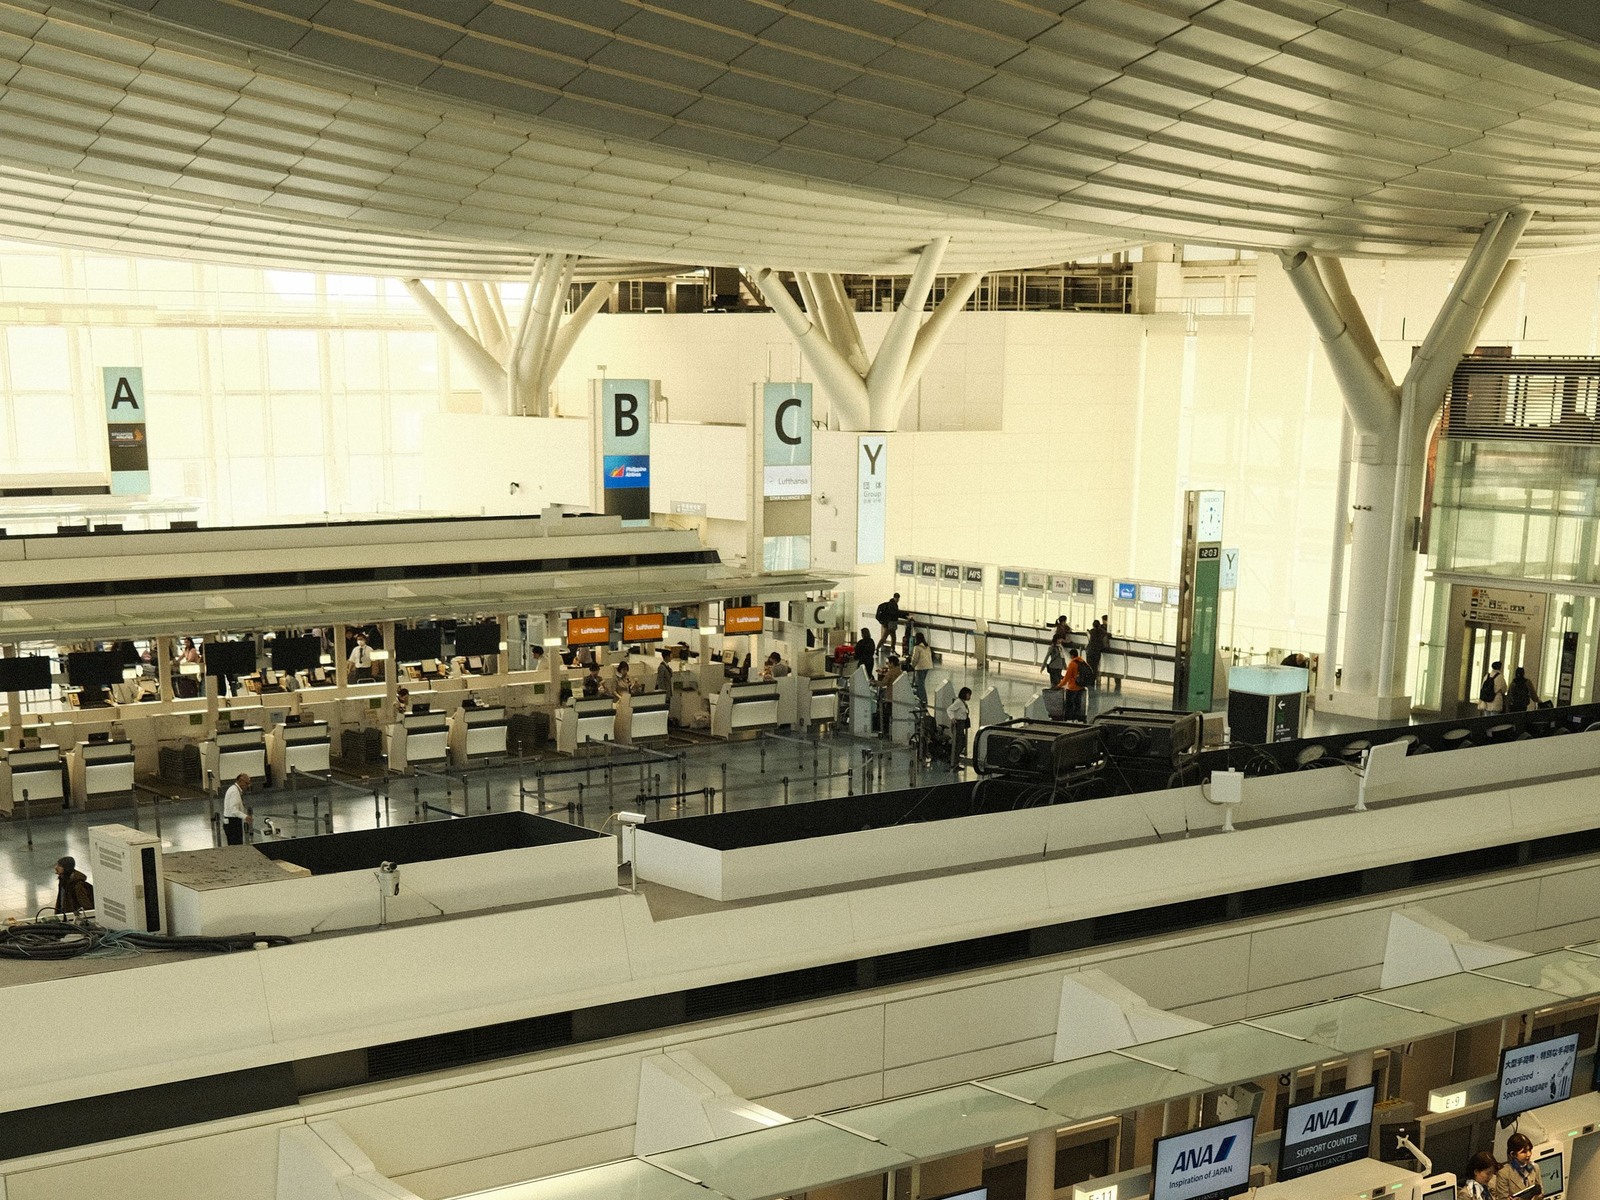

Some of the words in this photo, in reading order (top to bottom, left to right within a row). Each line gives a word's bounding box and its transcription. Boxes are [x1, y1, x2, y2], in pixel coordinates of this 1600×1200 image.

[111, 377, 139, 409] A
[615, 394, 639, 437] B
[775, 398, 802, 445] C
[863, 444, 883, 475] Y
[1226, 553, 1236, 569] Y
[814, 606, 825, 624] C
[1504, 1071, 1533, 1086] Oversized
[1445, 1096, 1460, 1109] E-9
[1502, 1087, 1524, 1101] Special
[1525, 1081, 1549, 1097] Baggage
[1301, 1107, 1338, 1135] ANA
[1296, 1142, 1326, 1158] SUPPORT
[1326, 1134, 1358, 1149] COUNTER
[1171, 1144, 1213, 1175] ANA
[1297, 1164, 1314, 1174] STAR
[1314, 1154, 1346, 1168] ALLIANCE
[1169, 1174, 1203, 1189] Inspiration
[1204, 1171, 1211, 1180] of
[1211, 1165, 1233, 1178] JAPAN
